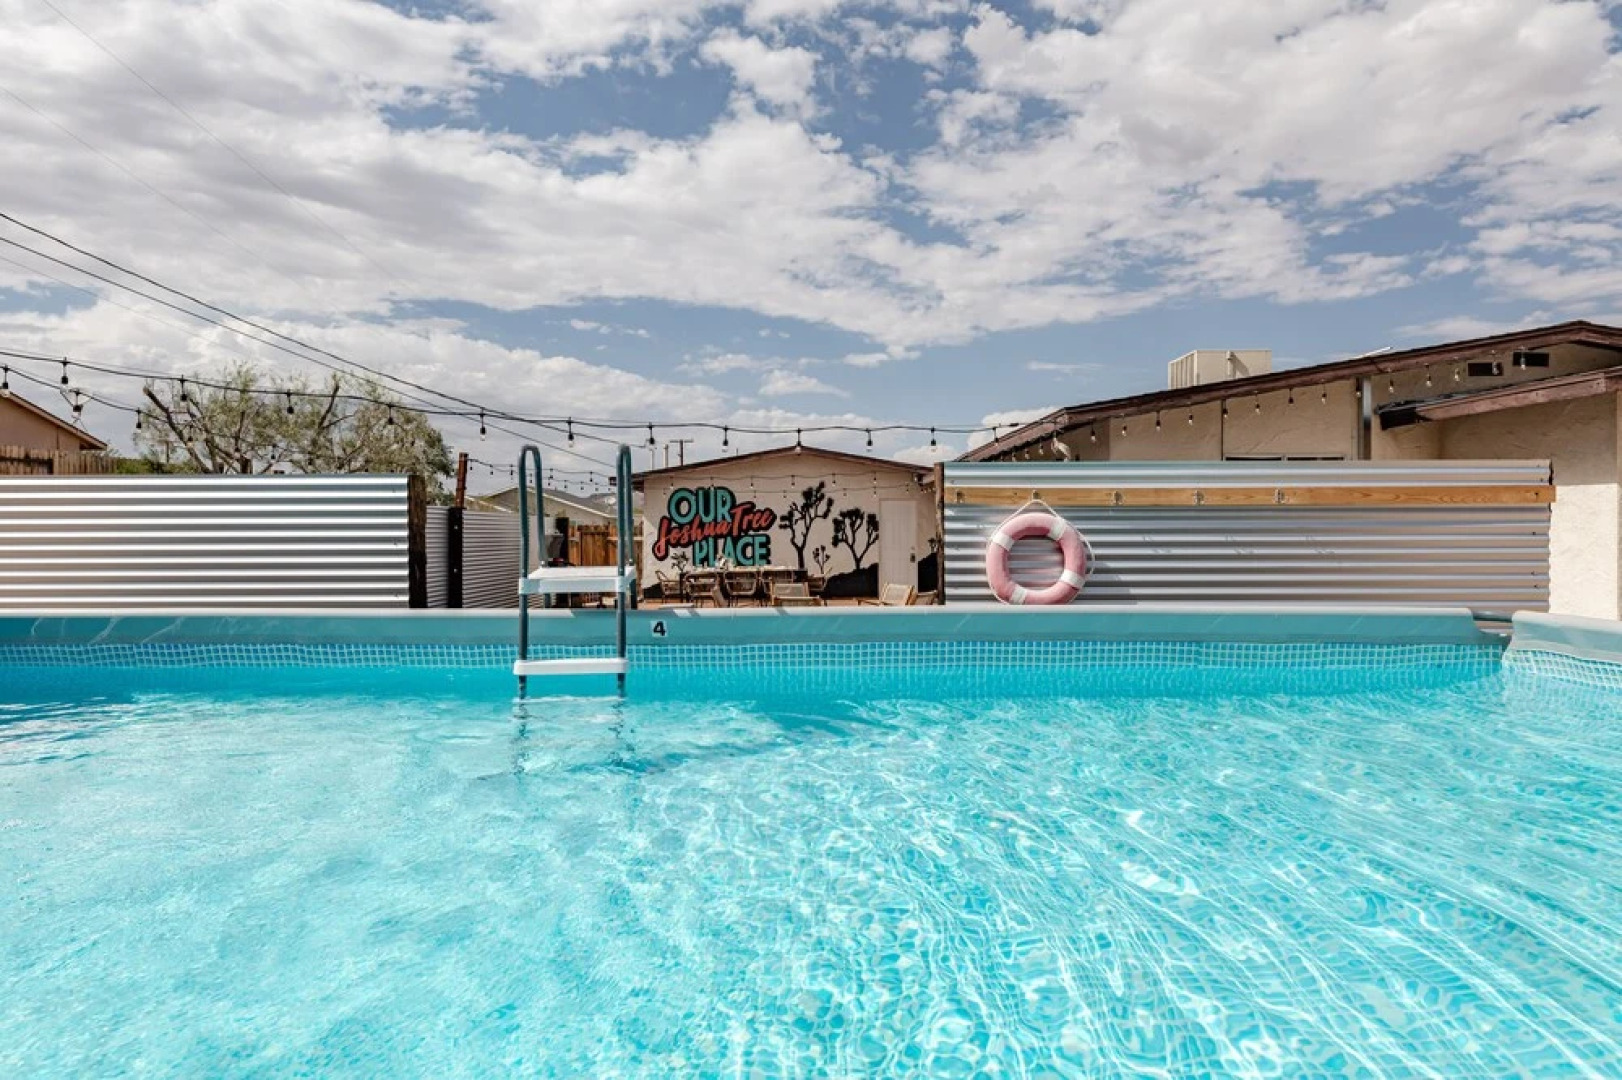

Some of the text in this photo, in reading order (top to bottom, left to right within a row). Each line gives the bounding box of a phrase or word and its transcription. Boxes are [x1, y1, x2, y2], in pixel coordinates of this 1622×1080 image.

[668, 487, 736, 524] OUR
[653, 501, 776, 560] Joshua Tree
[694, 533, 770, 567] PLACE
[653, 620, 666, 637] 4
